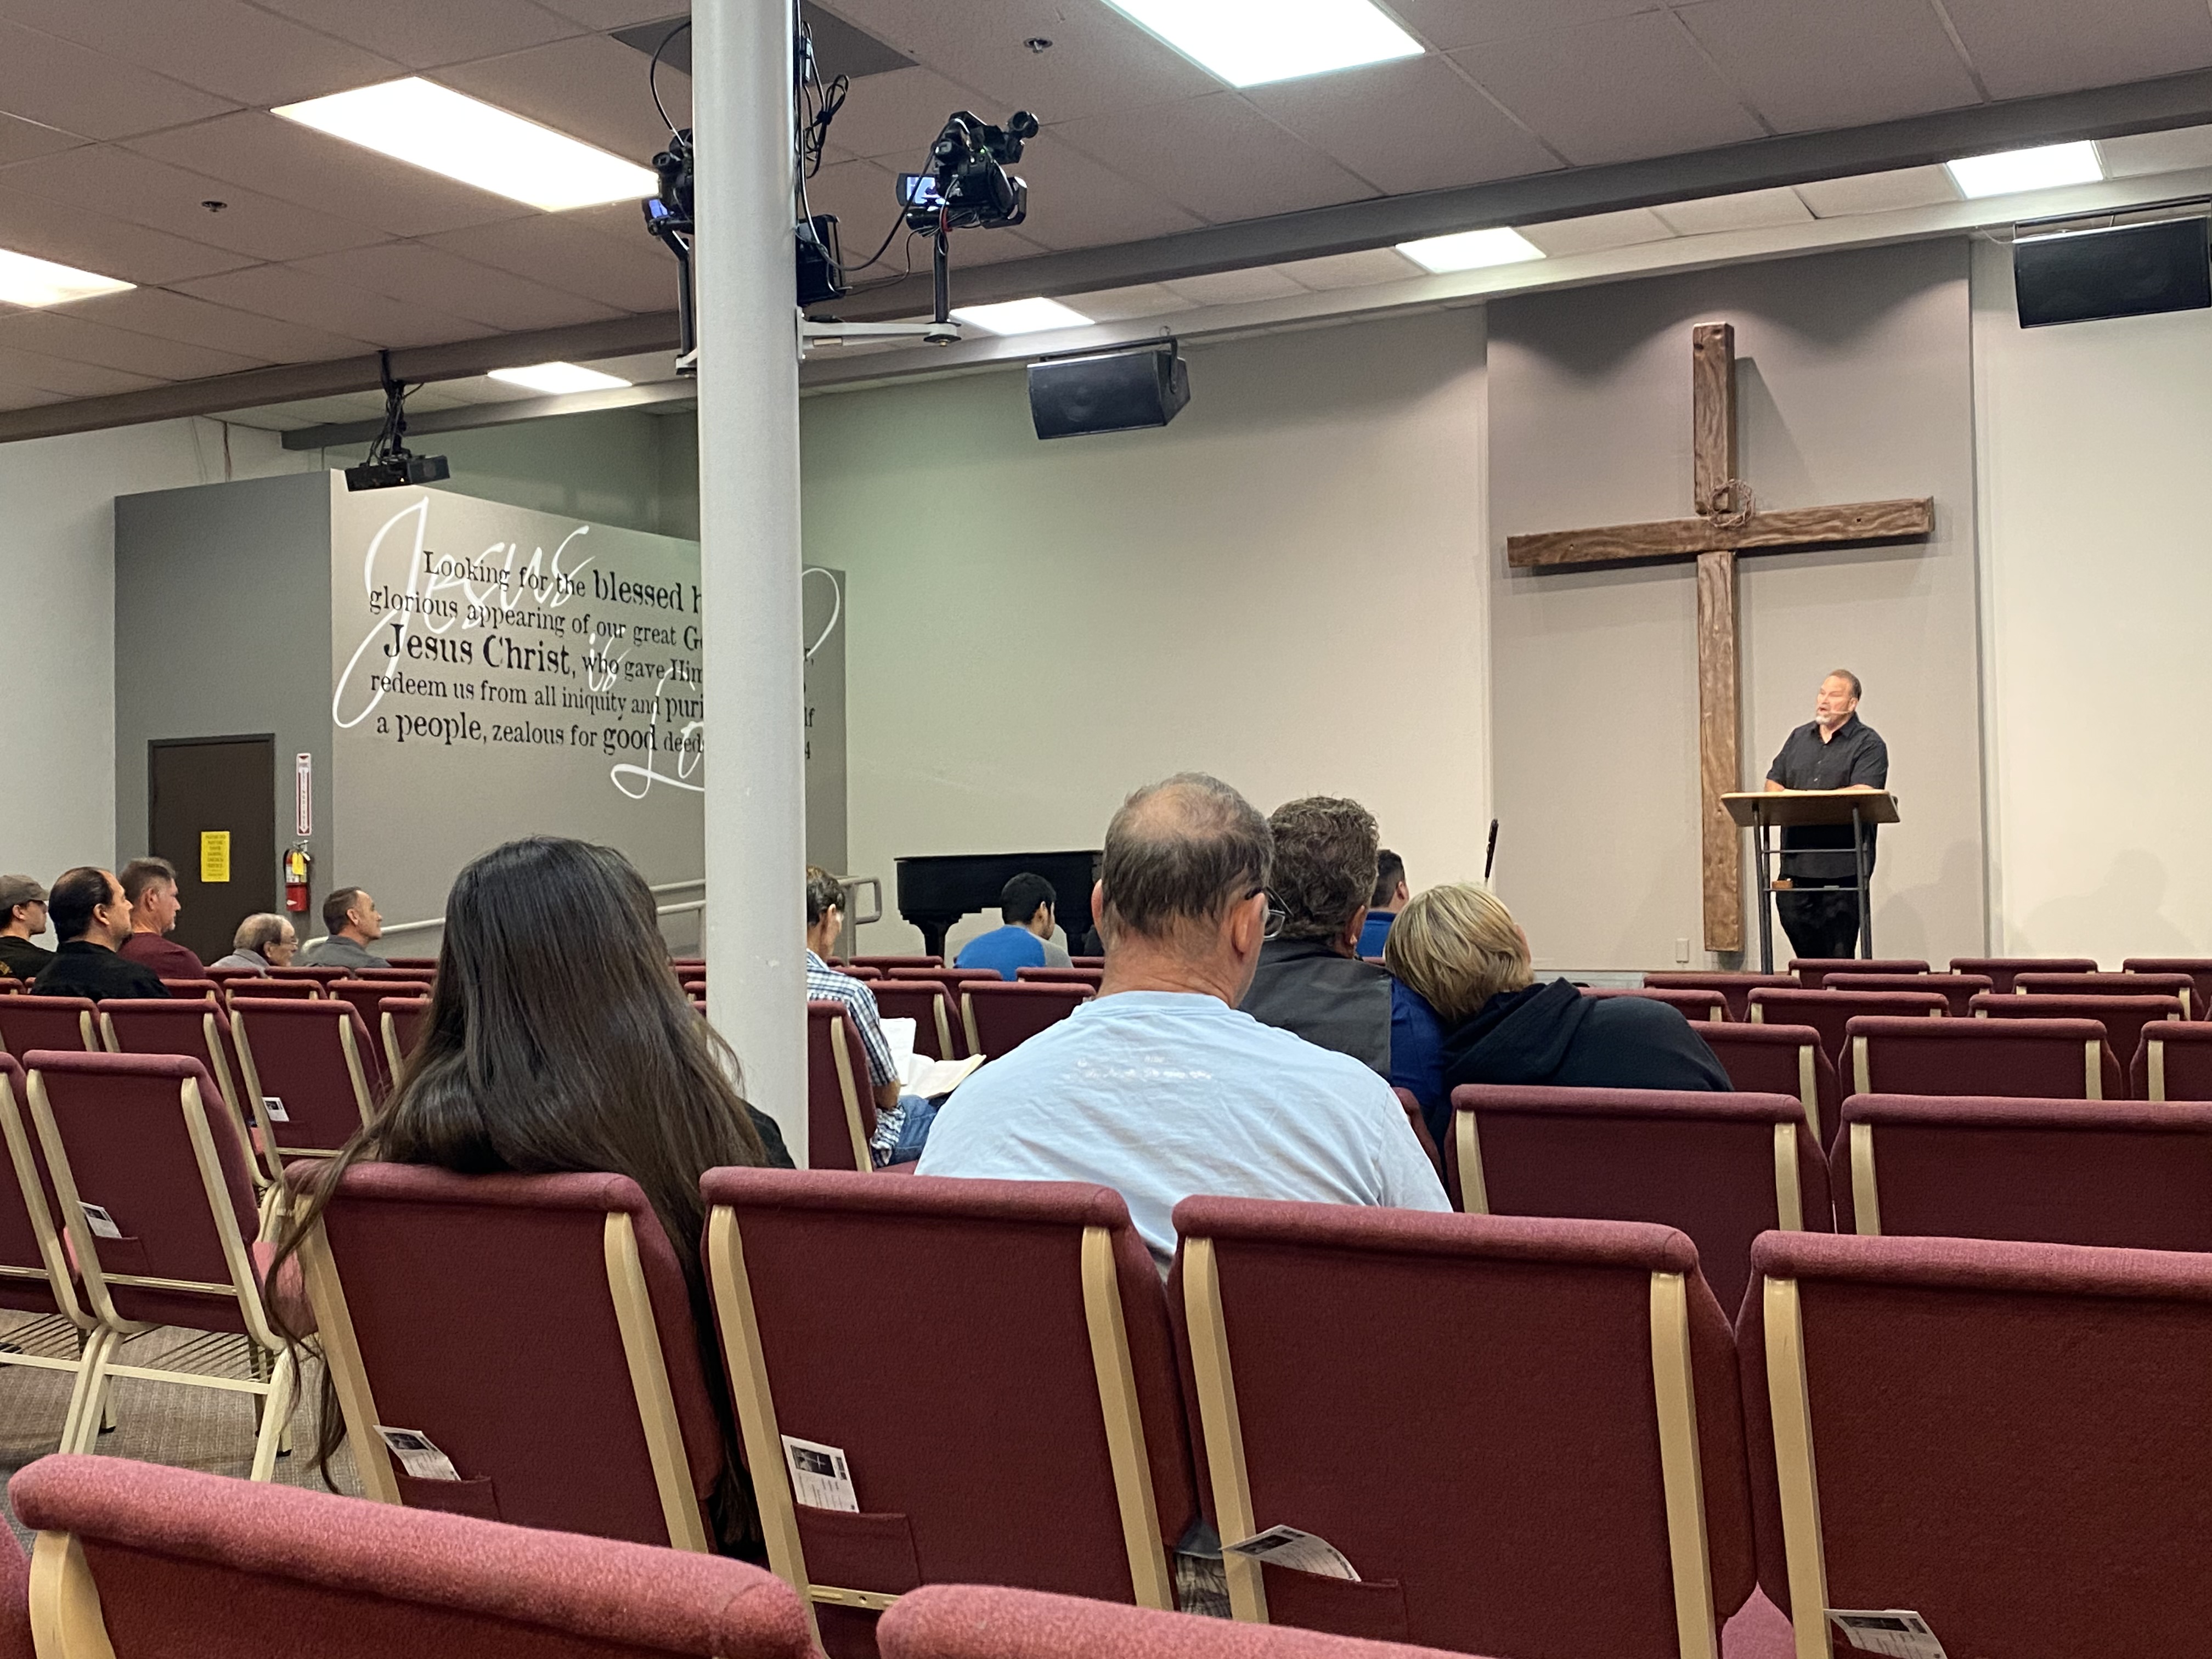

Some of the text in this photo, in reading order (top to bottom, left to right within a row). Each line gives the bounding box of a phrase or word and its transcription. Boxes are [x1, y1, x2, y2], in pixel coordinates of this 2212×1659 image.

[423, 550, 510, 591] Looking
[519, 567, 548, 590] for
[556, 573, 585, 597] the
[593, 569, 684, 612] blessed
[332, 496, 596, 729] Jesus
[369, 585, 458, 618] glorious
[466, 604, 566, 637] appearing
[572, 614, 590, 634] of
[597, 620, 626, 638] our
[633, 625, 676, 646] great
[383, 623, 472, 664] Jesus
[483, 635, 575, 679] Christ,
[582, 653, 619, 674] who
[624, 661, 665, 682] gave
[371, 672, 703, 723] redeem us from all iniquity and puri
[376, 712, 704, 755] a people, zealous for good deed
